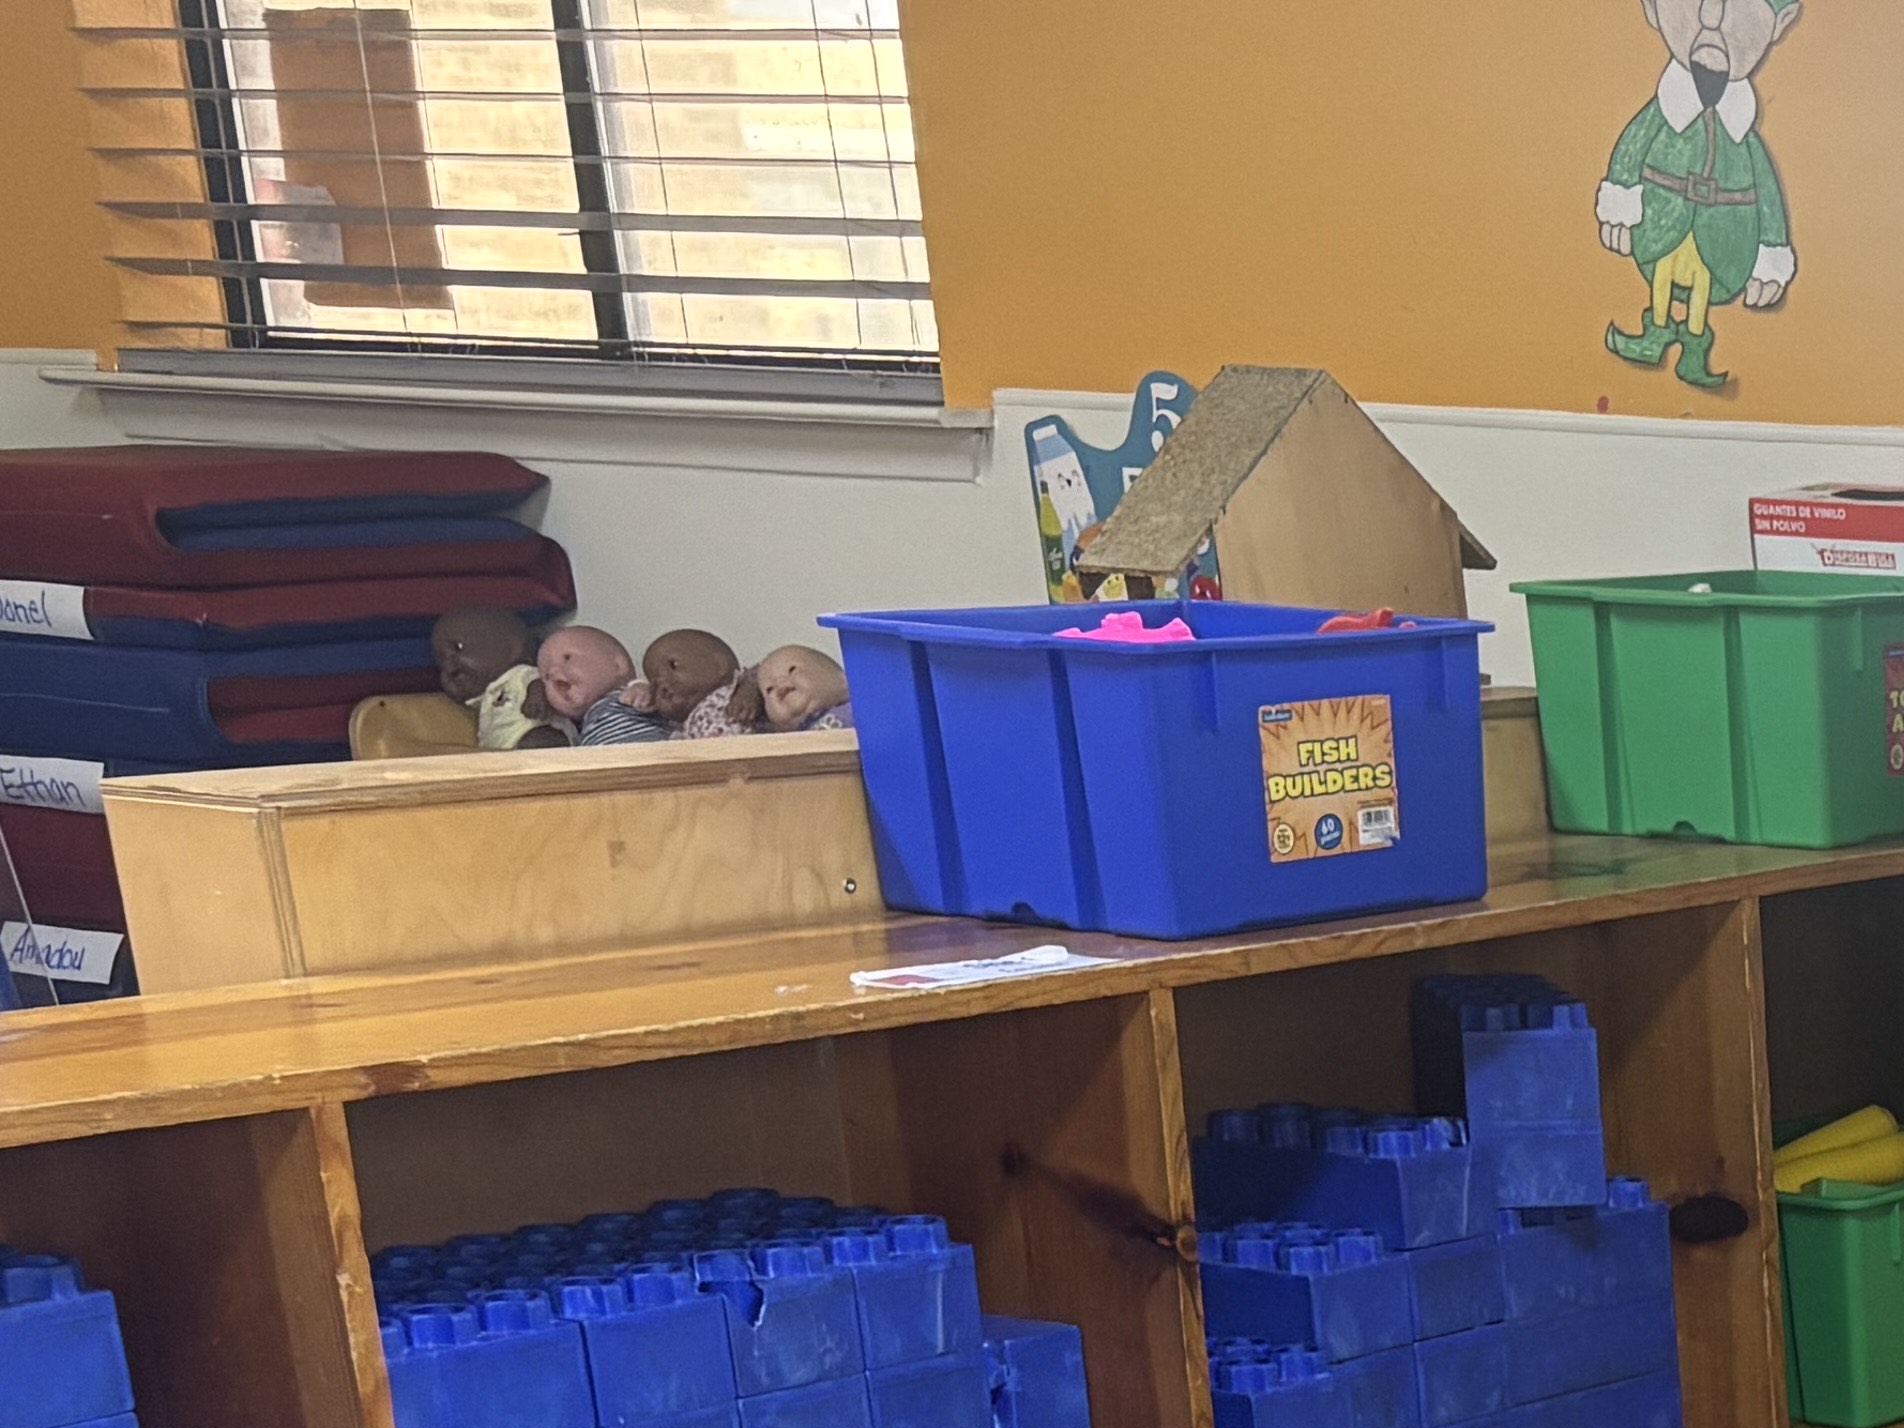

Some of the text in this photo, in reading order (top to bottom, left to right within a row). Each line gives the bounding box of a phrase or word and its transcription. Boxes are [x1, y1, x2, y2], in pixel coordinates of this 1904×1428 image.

[1297, 735, 1359, 767] FISH
[0, 768, 86, 807] Ethan
[1268, 762, 1394, 803] BUILDERS
